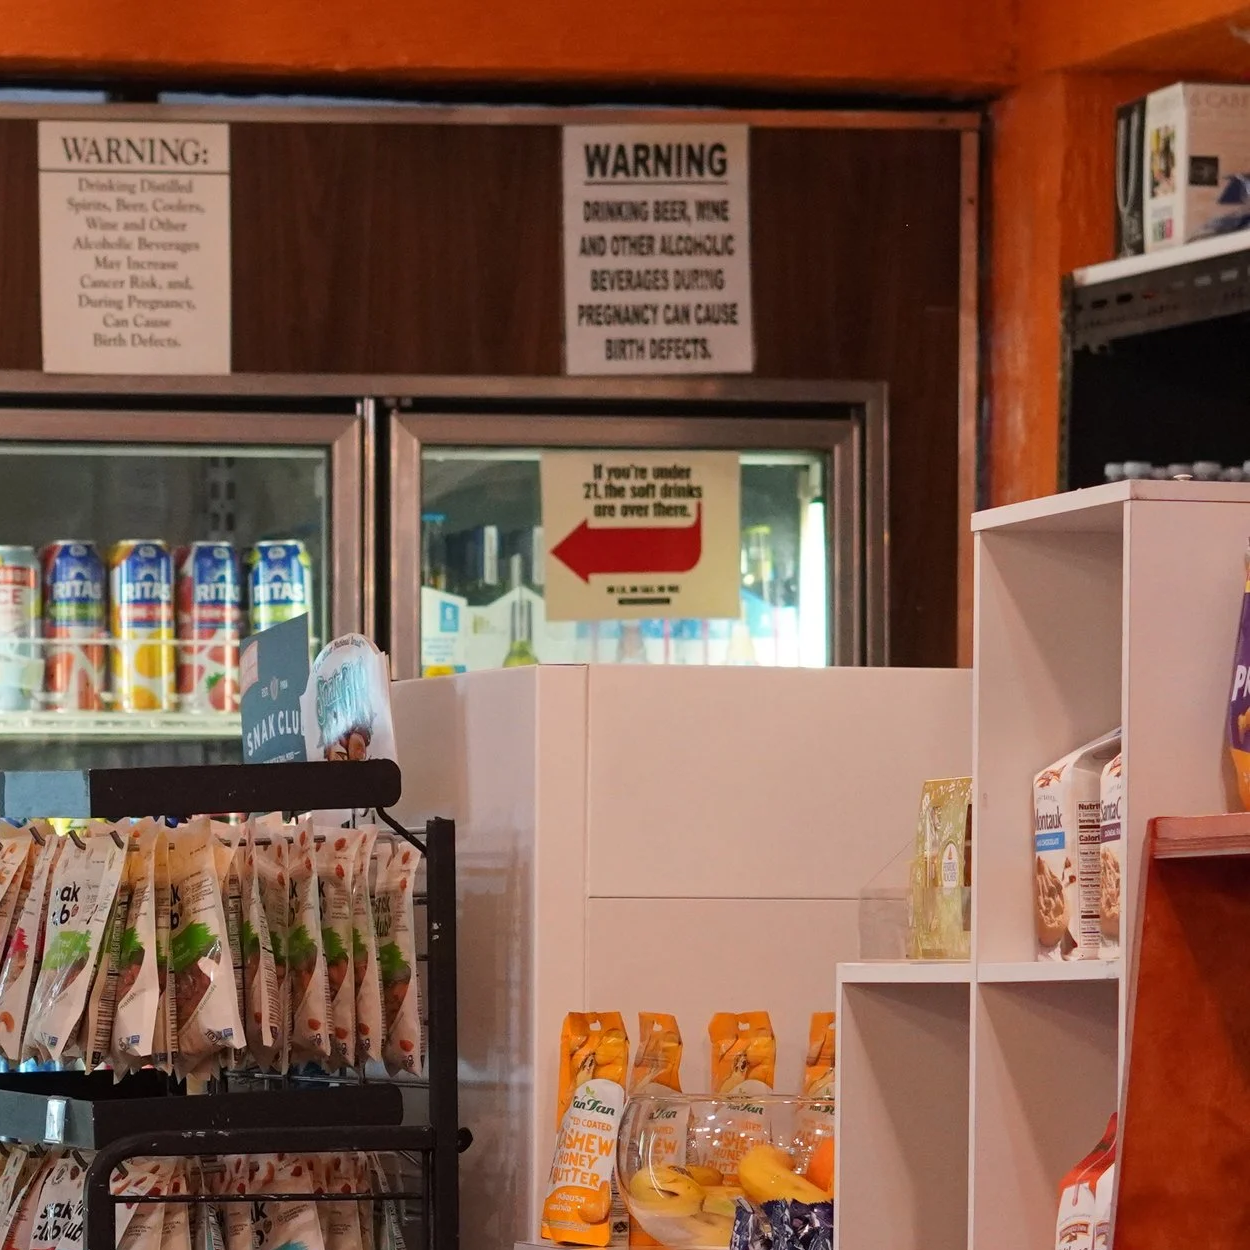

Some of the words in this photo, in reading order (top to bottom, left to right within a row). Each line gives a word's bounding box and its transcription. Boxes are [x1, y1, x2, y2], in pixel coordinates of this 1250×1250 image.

[61, 136, 209, 166] WARNING:
[583, 143, 728, 178] WARNING
[78, 178, 136, 195] Drinking
[140, 178, 193, 194] Distilled
[66, 198, 112, 214] Spirits,
[116, 199, 149, 213] Beer,
[152, 199, 205, 214] Coolers,
[583, 200, 648, 222] DRINKING
[653, 200, 691, 226] BEER,
[695, 200, 730, 222] WINE
[86, 217, 118, 231] Wine
[122, 217, 145, 231] and
[149, 217, 187, 231] Other
[73, 236, 132, 250] Alcoholic
[137, 237, 200, 253] Beverages
[579, 235, 607, 257] AND
[611, 235, 655, 256] OTHER
[659, 234, 735, 256] ALCOHOLIC
[94, 256, 121, 271] May
[126, 256, 178, 270] Increase
[80, 275, 125, 289] Cancer
[129, 275, 162, 290] Risk,
[590, 269, 669, 291] BEVERAGES
[673, 268, 725, 291] DURING
[78, 294, 124, 310] During
[128, 295, 197, 312] Pregnancy,
[102, 314, 128, 328] Can
[133, 314, 171, 328] Cause
[577, 303, 658, 326] PREGNANCY
[663, 303, 691, 325] CAN
[695, 302, 739, 325] CAUSE
[93, 332, 127, 347] Birth
[131, 333, 181, 348] Defects.
[605, 338, 645, 361] BIRTH
[649, 338, 712, 360] DEFECTS.
[593, 464, 603, 479] If
[607, 464, 648, 481] you're
[652, 464, 692, 479] under
[604, 483, 626, 499] the
[630, 482, 655, 499] soft
[659, 483, 703, 499] drinks
[593, 503, 616, 518] are
[620, 503, 649, 518] over
[653, 502, 691, 518] there.
[122, 580, 171, 599] RITAS
[254, 580, 304, 600] RITAS
[246, 714, 277, 757] SNAK
[582, 1119, 612, 1132] COATED
[558, 1150, 599, 1169] HONEY
